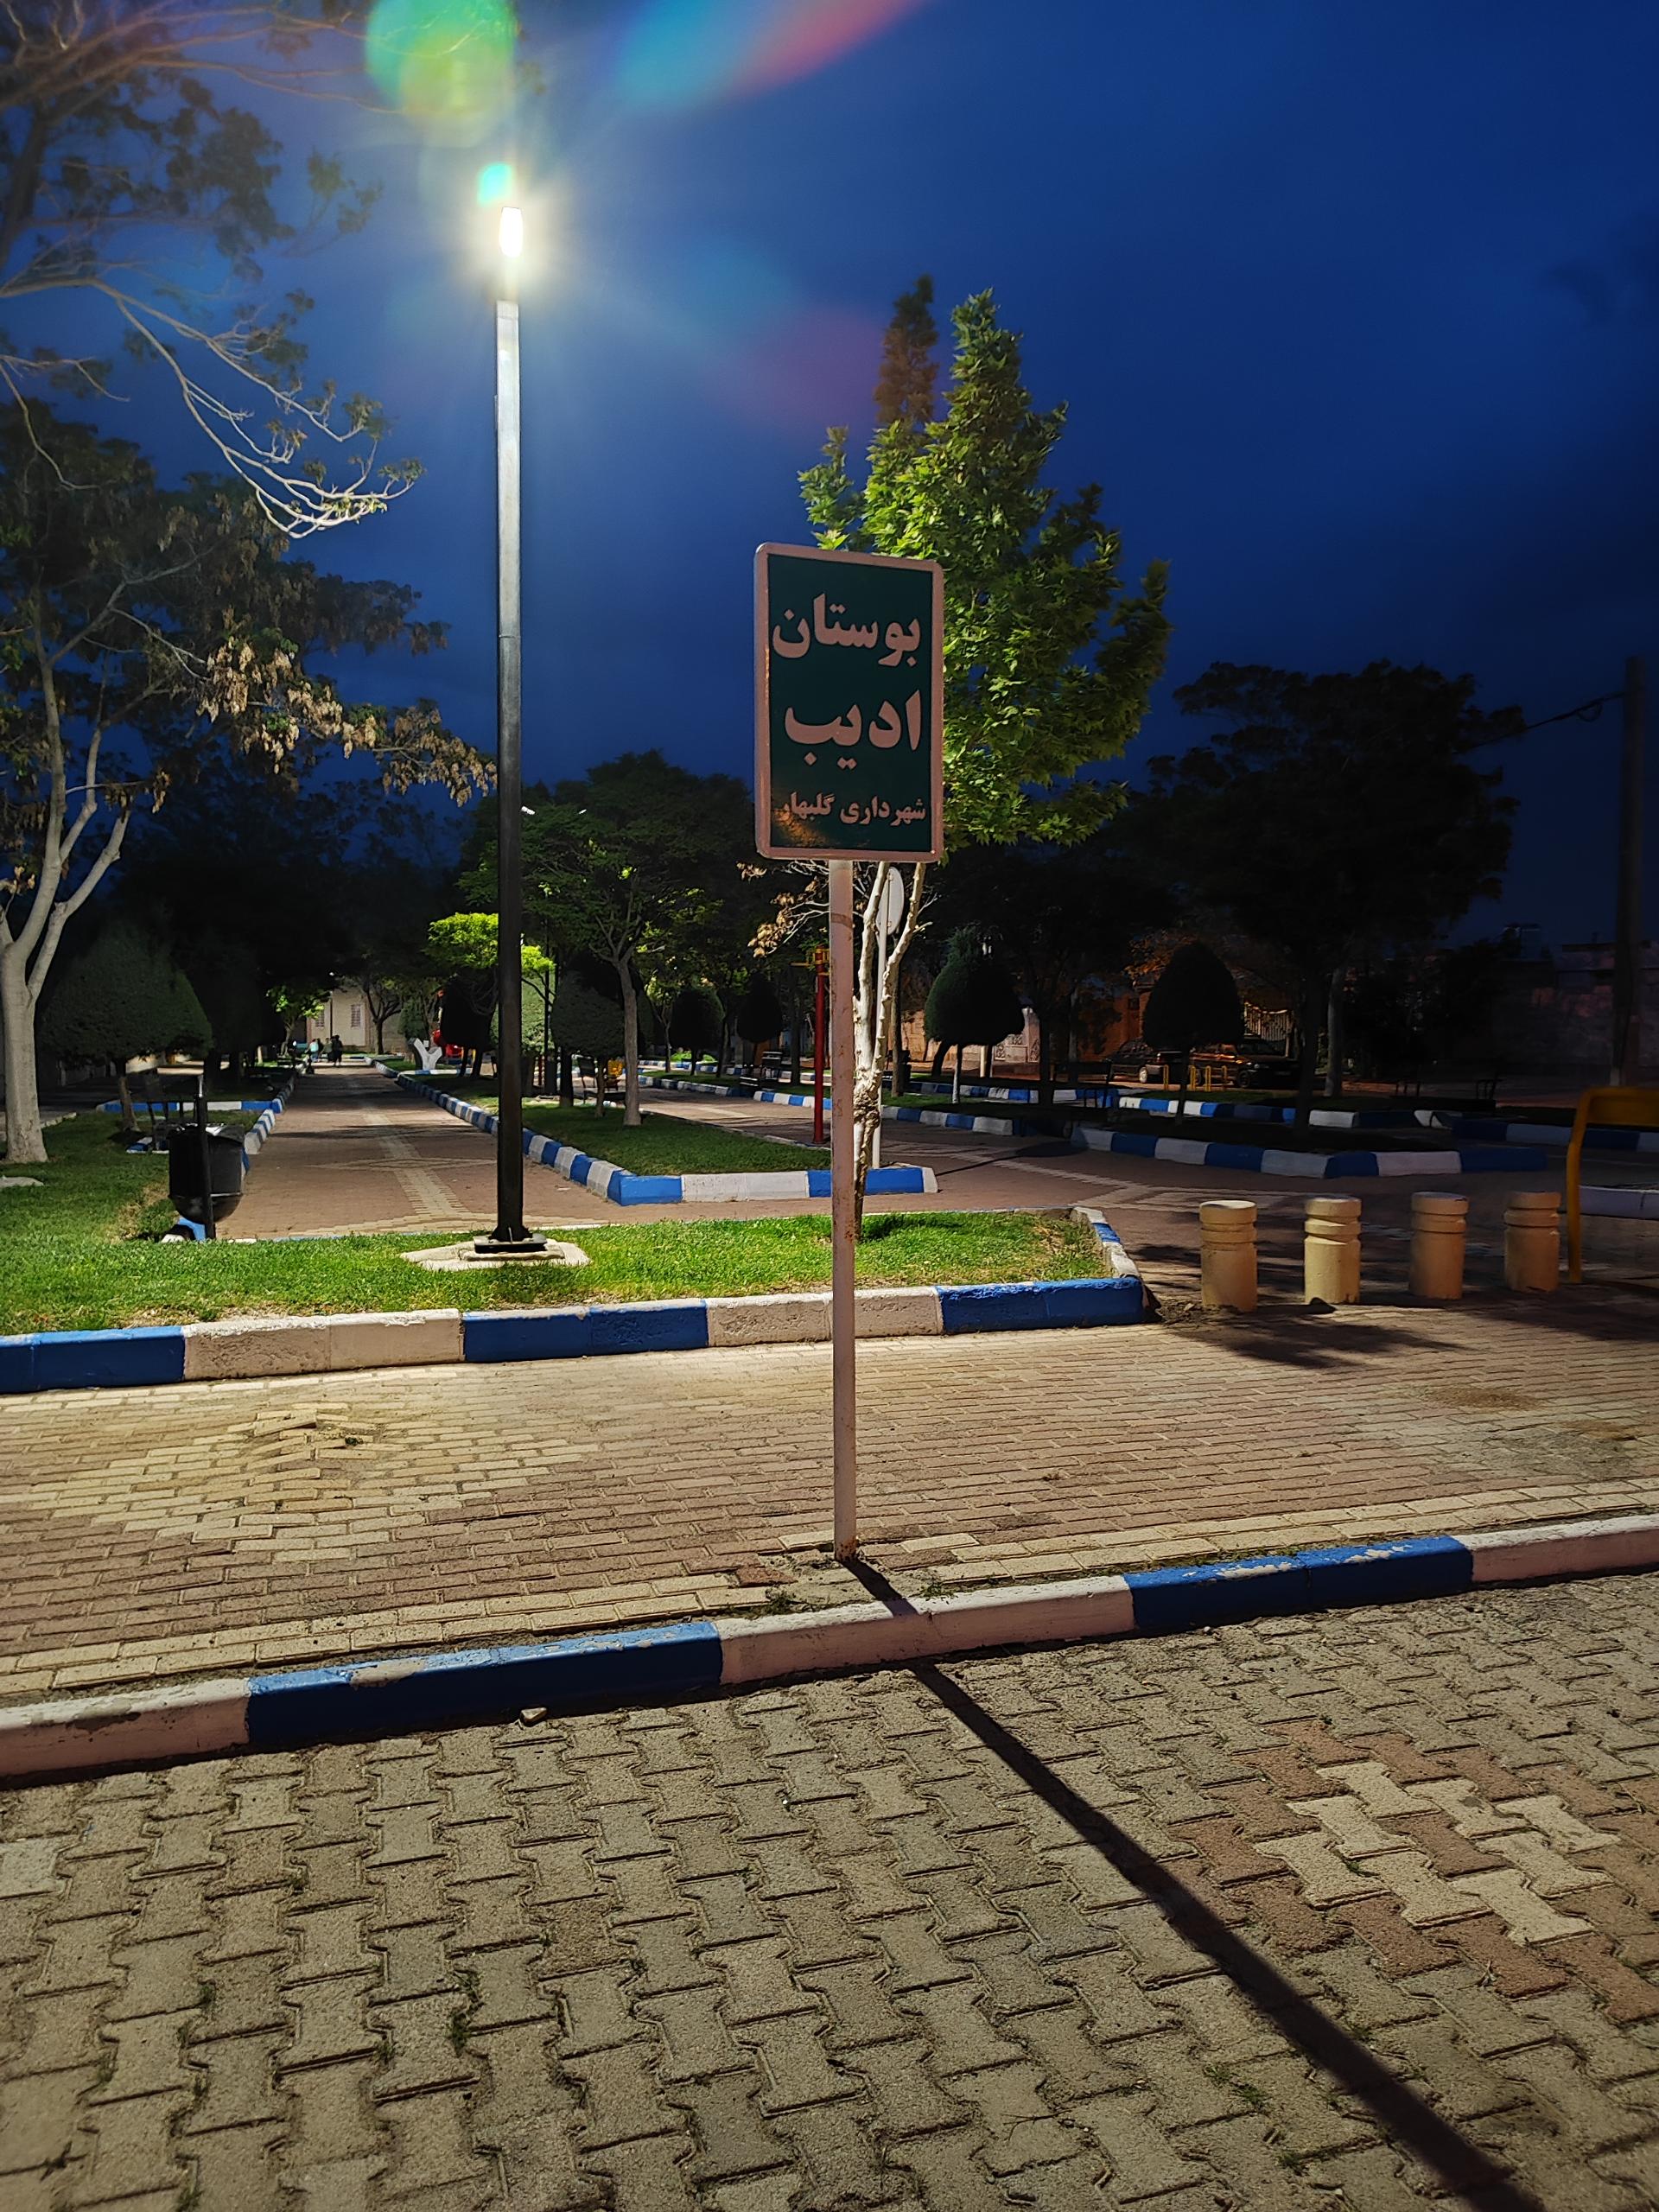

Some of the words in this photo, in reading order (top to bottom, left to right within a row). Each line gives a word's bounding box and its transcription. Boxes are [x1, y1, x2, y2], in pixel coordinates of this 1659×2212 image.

[772, 593, 921, 667] بوستان
[785, 690, 922, 770] ادیب
[839, 795, 927, 827] شهرداری
